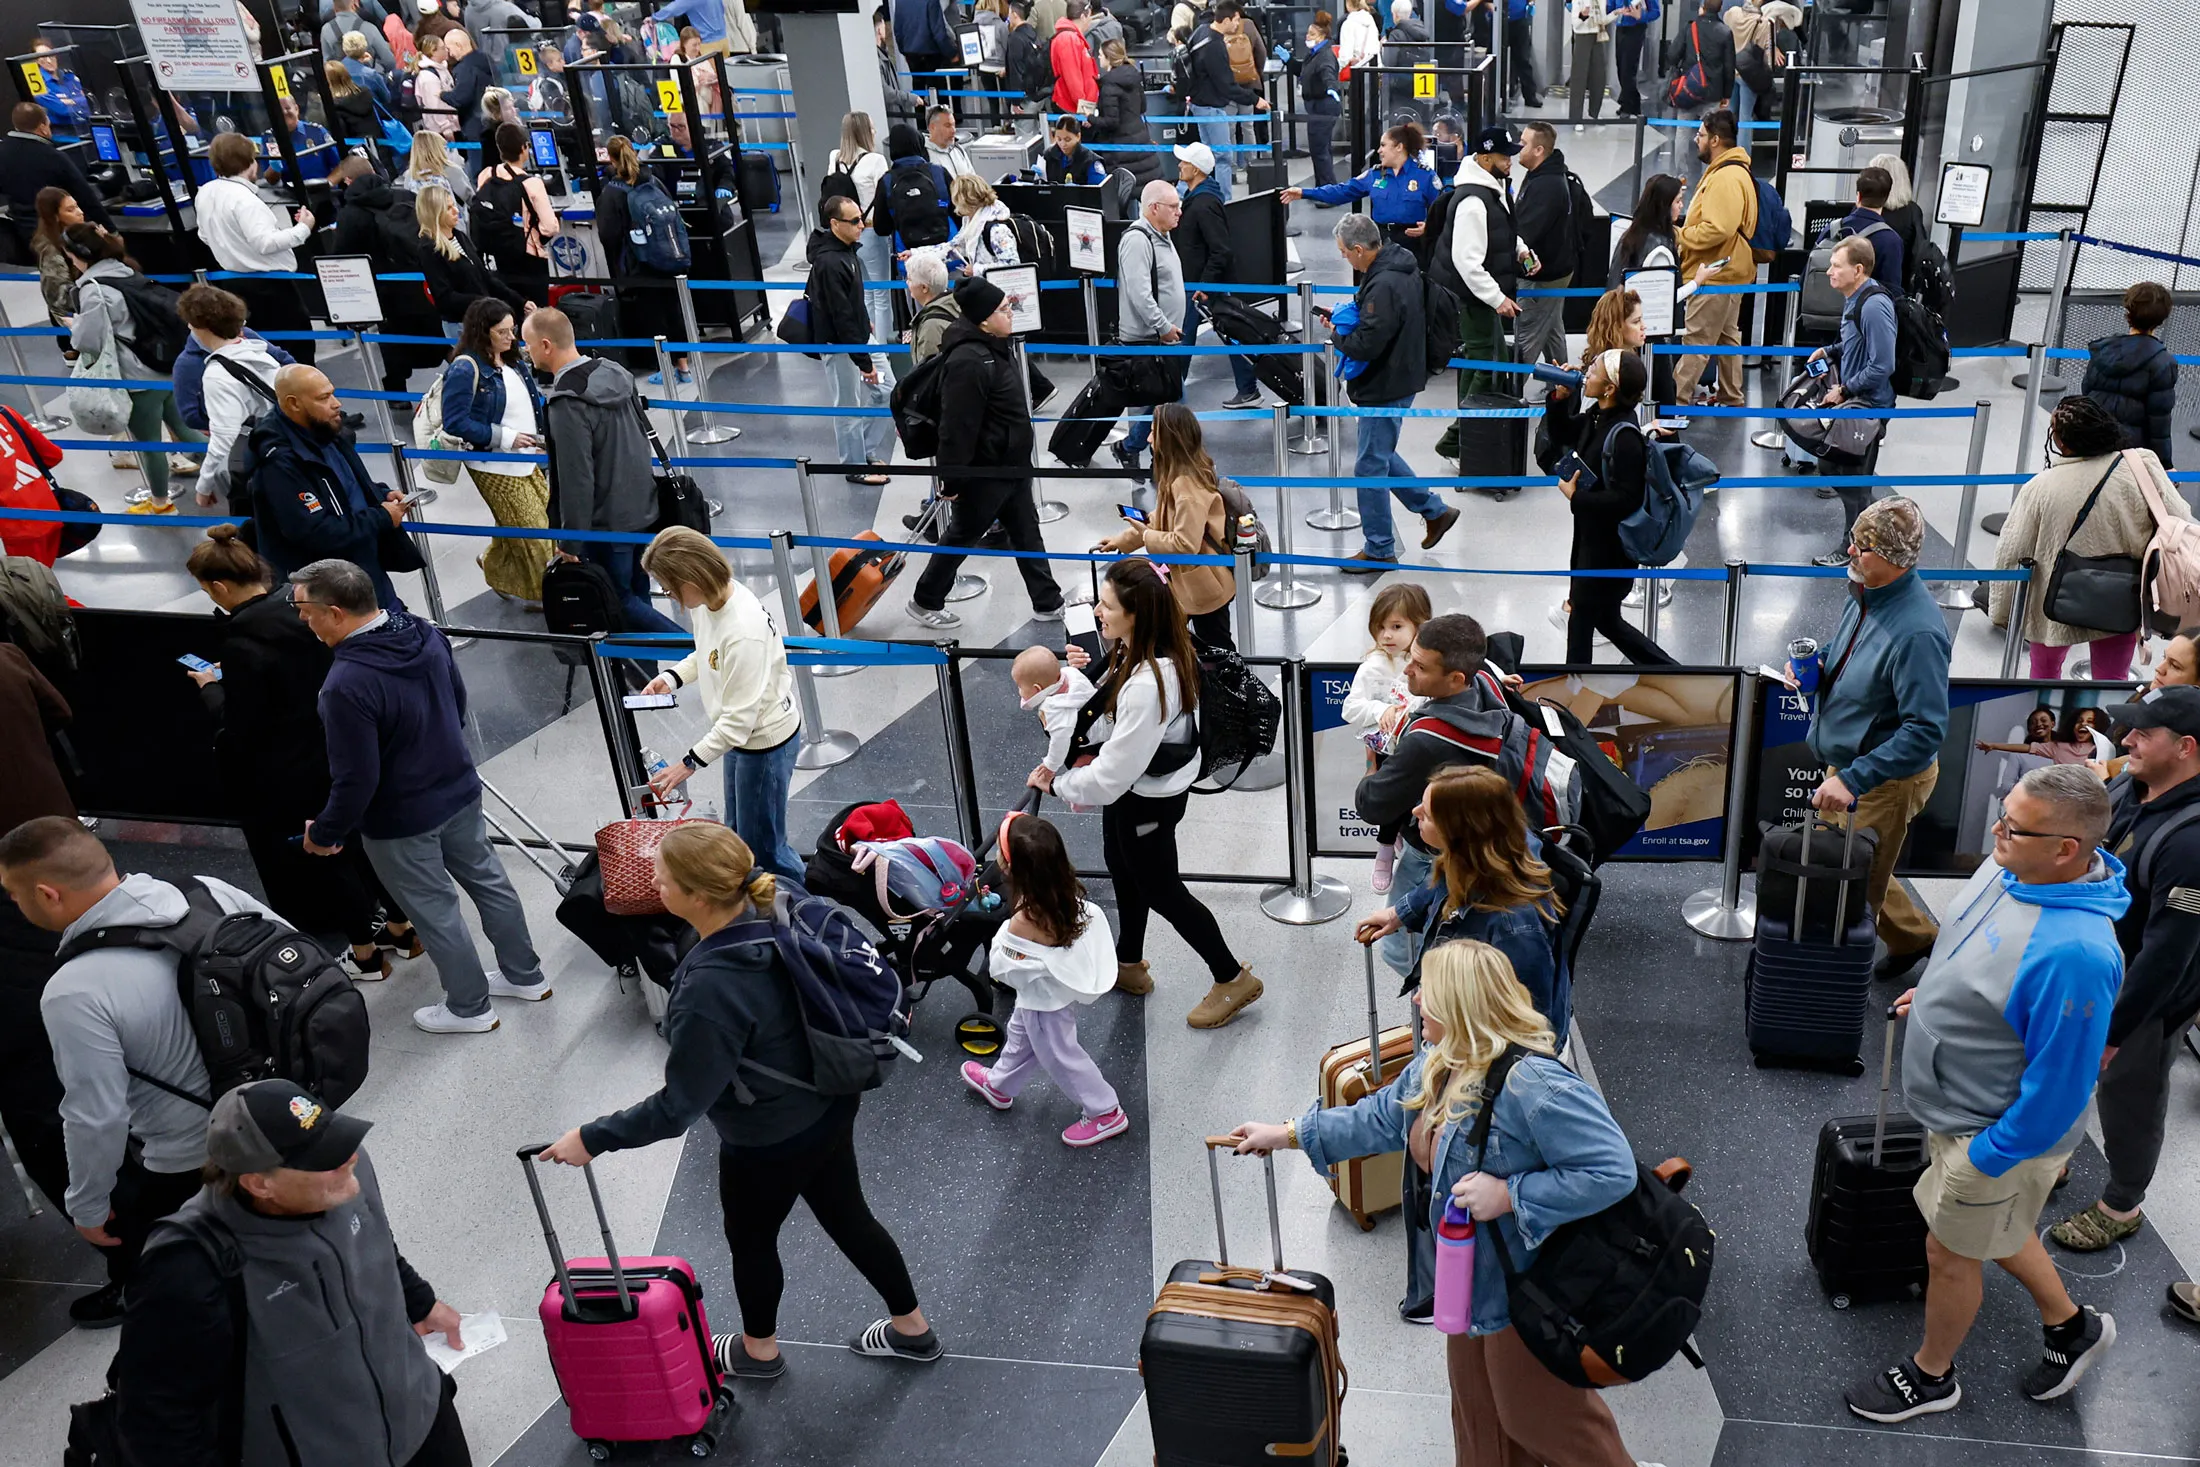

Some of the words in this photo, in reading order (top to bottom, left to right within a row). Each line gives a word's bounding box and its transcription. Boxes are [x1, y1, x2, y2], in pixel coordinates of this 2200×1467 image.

[520, 51, 533, 72] 3
[28, 73, 42, 93] 5
[278, 76, 287, 95] 4
[1419, 75, 1431, 95] 1
[663, 90, 678, 110] 2
[1322, 680, 1351, 694] TSA
[1325, 697, 1344, 705] Trav
[1779, 713, 1806, 721] Travel
[1785, 787, 1803, 798] so
[1339, 808, 1361, 820] Ess
[1339, 825, 1379, 837] trave
[1642, 837, 1667, 845] Enroll
[1679, 837, 1710, 846] tsa.gov
